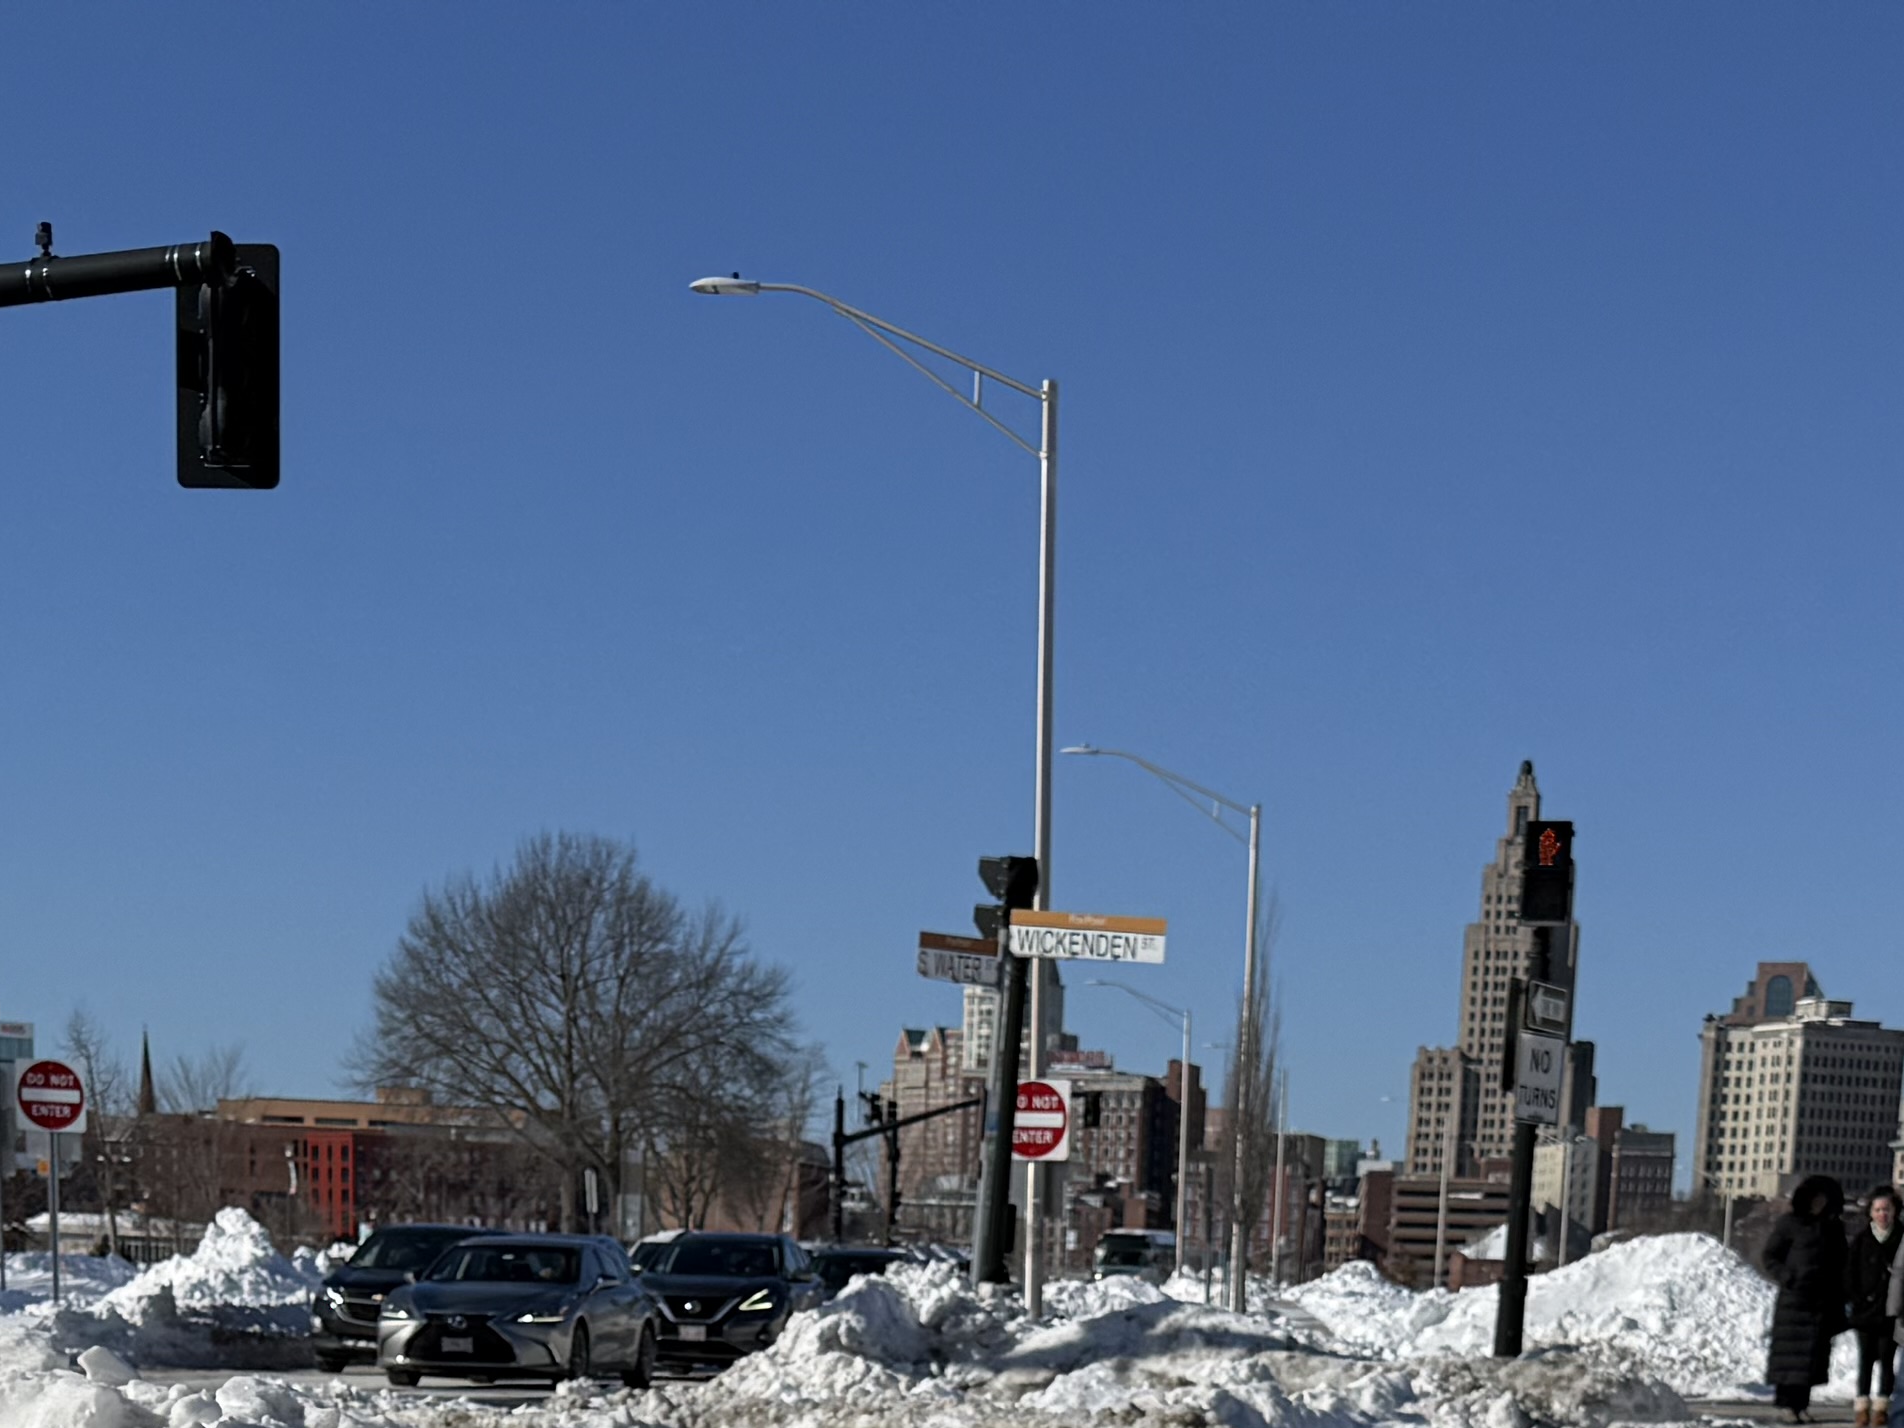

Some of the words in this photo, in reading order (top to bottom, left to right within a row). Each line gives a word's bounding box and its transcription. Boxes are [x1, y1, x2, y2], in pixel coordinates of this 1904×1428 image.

[1017, 928, 1138, 960] WICKENDEN
[934, 952, 982, 984] WATER
[1529, 1048, 1551, 1075] NO
[26, 1072, 45, 1085] DO
[50, 1073, 74, 1087] NOT
[1032, 1094, 1059, 1109] NOT
[1519, 1085, 1556, 1110] TURNS
[31, 1104, 71, 1118] ENTER
[1012, 1130, 1053, 1144] ENTER
